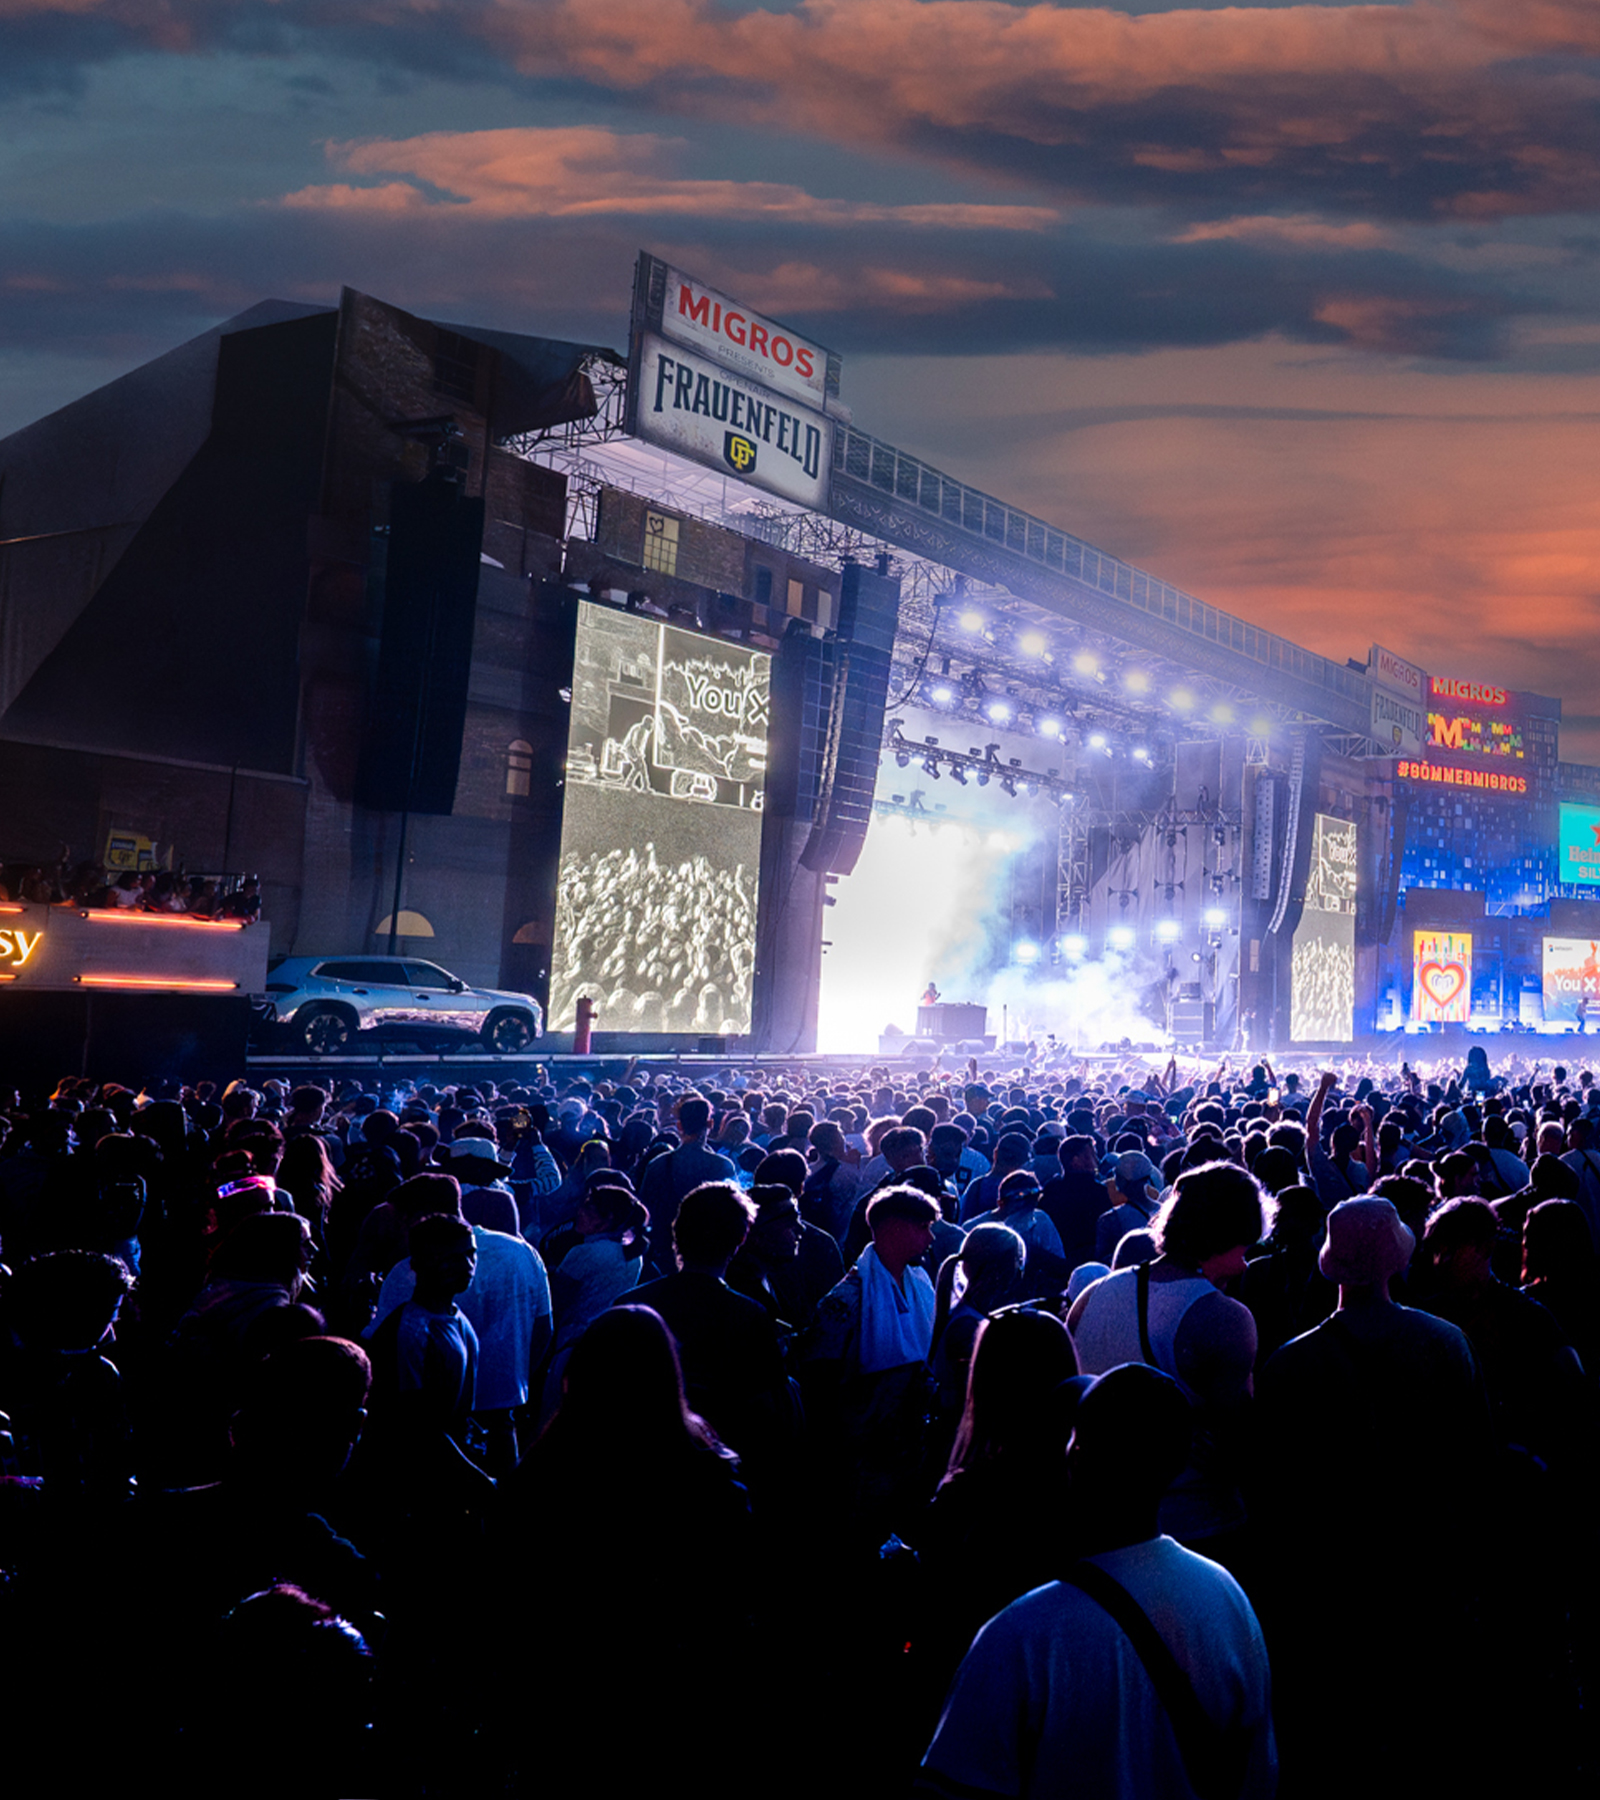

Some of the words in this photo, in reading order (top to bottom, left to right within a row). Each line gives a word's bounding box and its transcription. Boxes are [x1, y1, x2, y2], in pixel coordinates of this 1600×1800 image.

[678, 284, 815, 378] MIGROS
[717, 344, 776, 379] PRESENTS
[719, 370, 772, 399] OPENAIR
[653, 353, 821, 480] FRAUENFELD
[1380, 653, 1418, 688] MIGROS
[686, 672, 742, 718] You
[1432, 676, 1506, 704] MIGROS
[1373, 692, 1421, 742] FRAUENFELD
[1434, 715, 1463, 748] M
[1555, 974, 1580, 991] You
